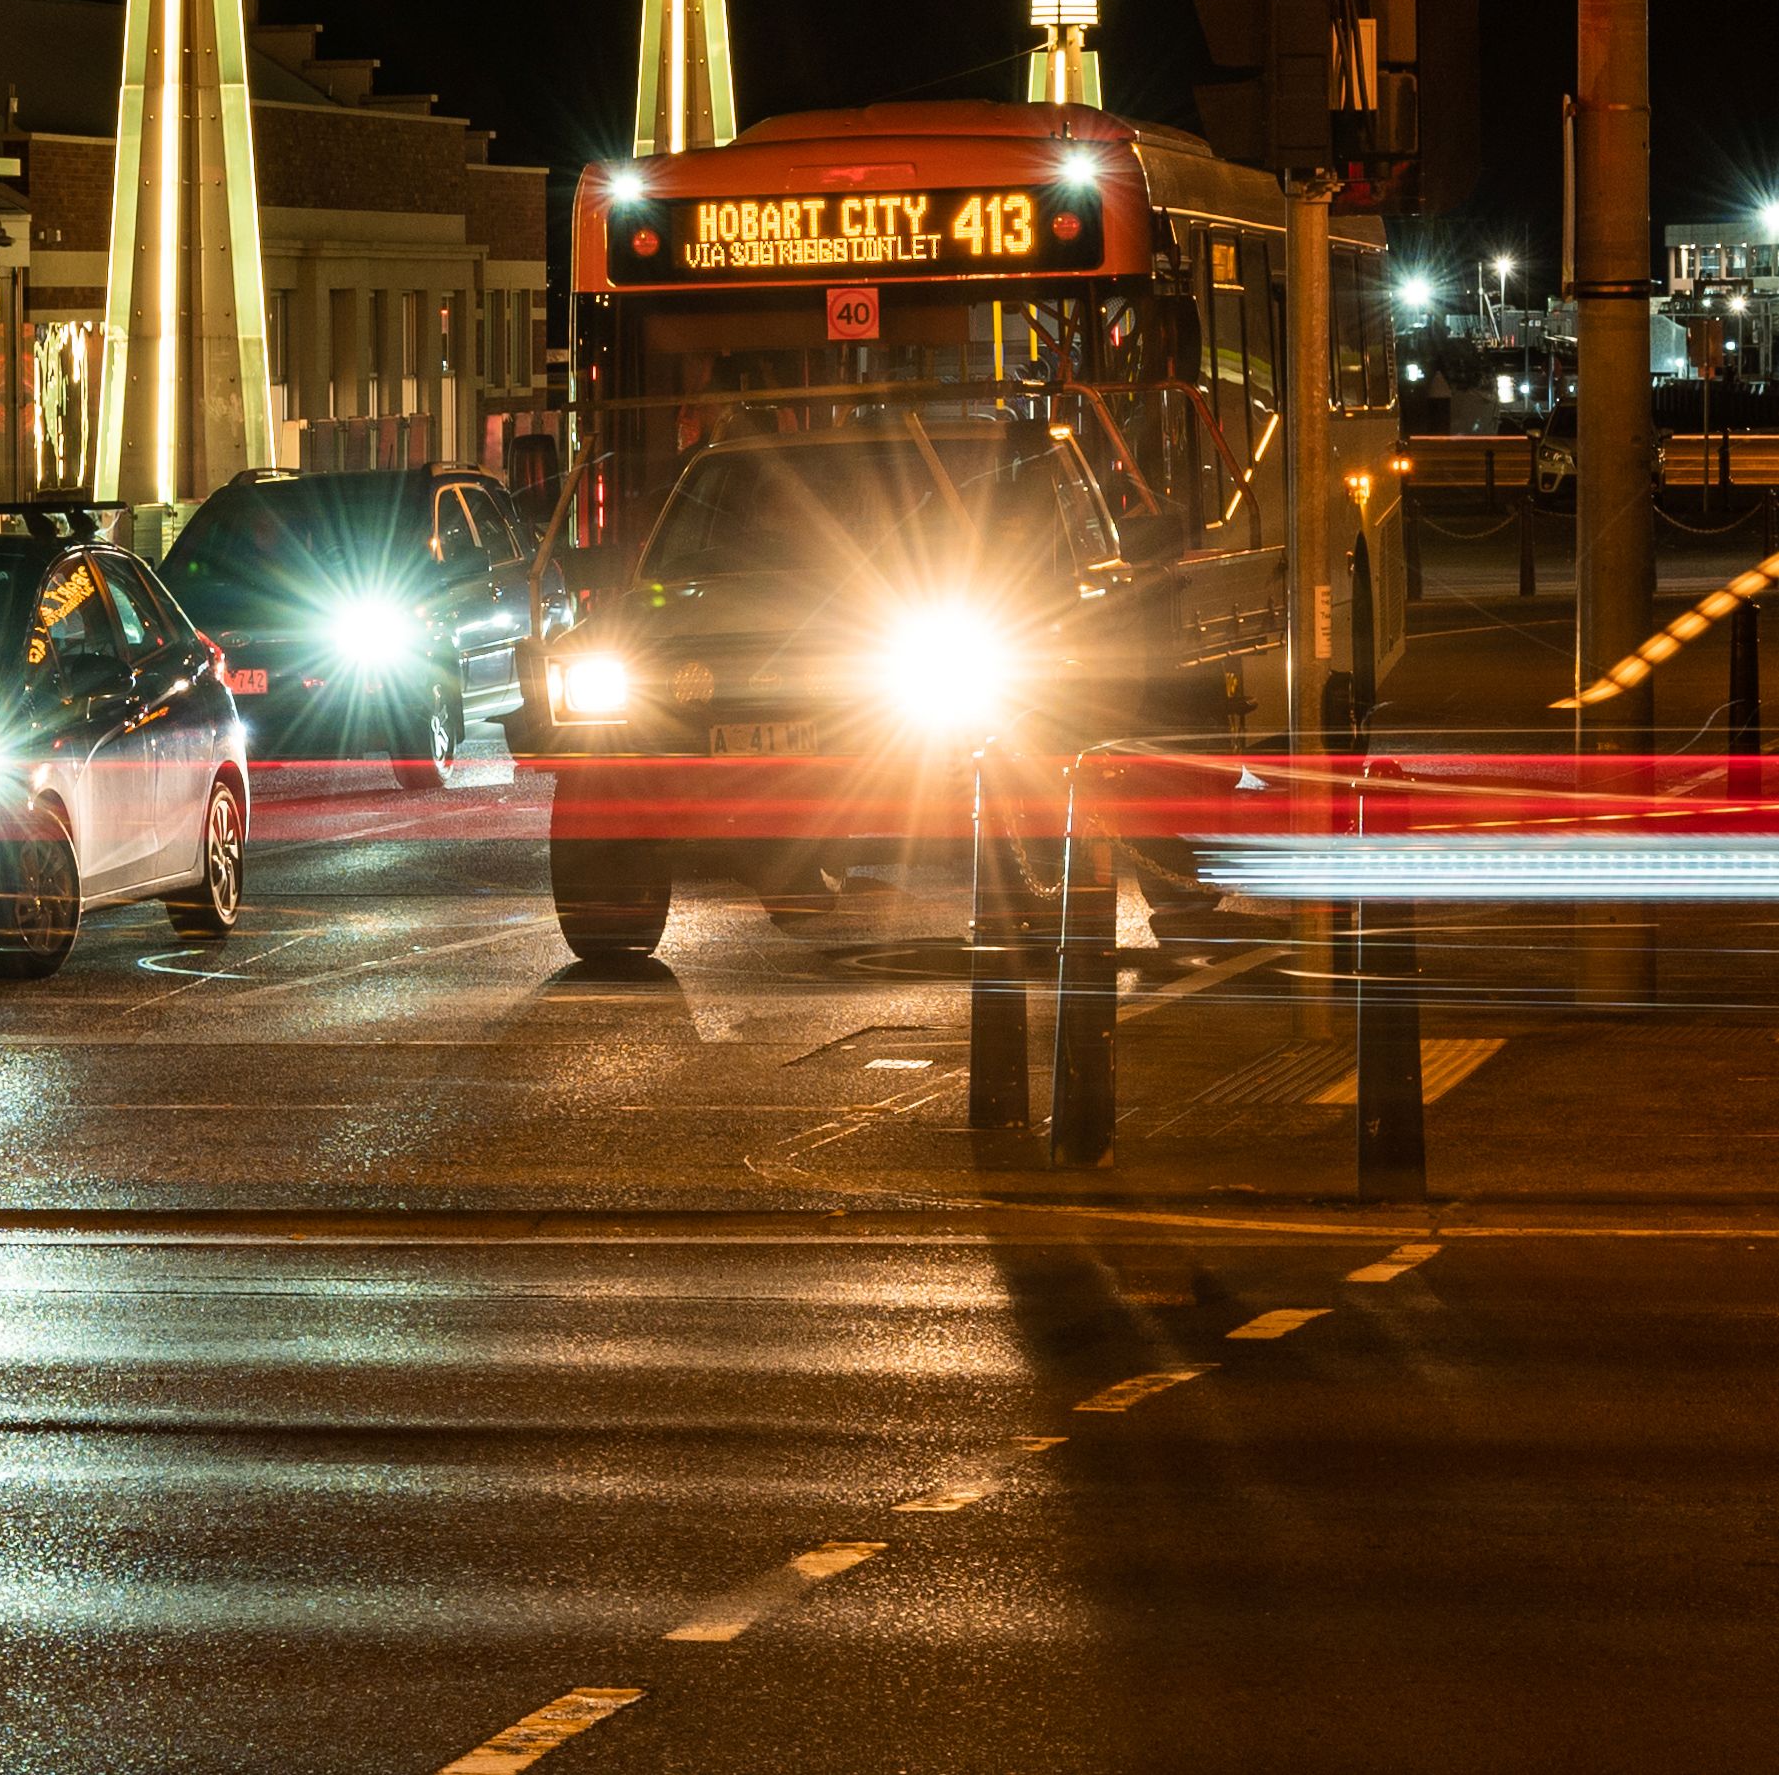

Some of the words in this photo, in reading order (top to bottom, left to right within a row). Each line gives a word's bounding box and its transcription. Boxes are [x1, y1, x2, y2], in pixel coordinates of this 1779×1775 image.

[698, 199, 826, 241] HOBART
[841, 196, 927, 237] CITY
[952, 194, 1034, 256] 413
[684, 241, 726, 268] VIA
[836, 302, 870, 325] 40
